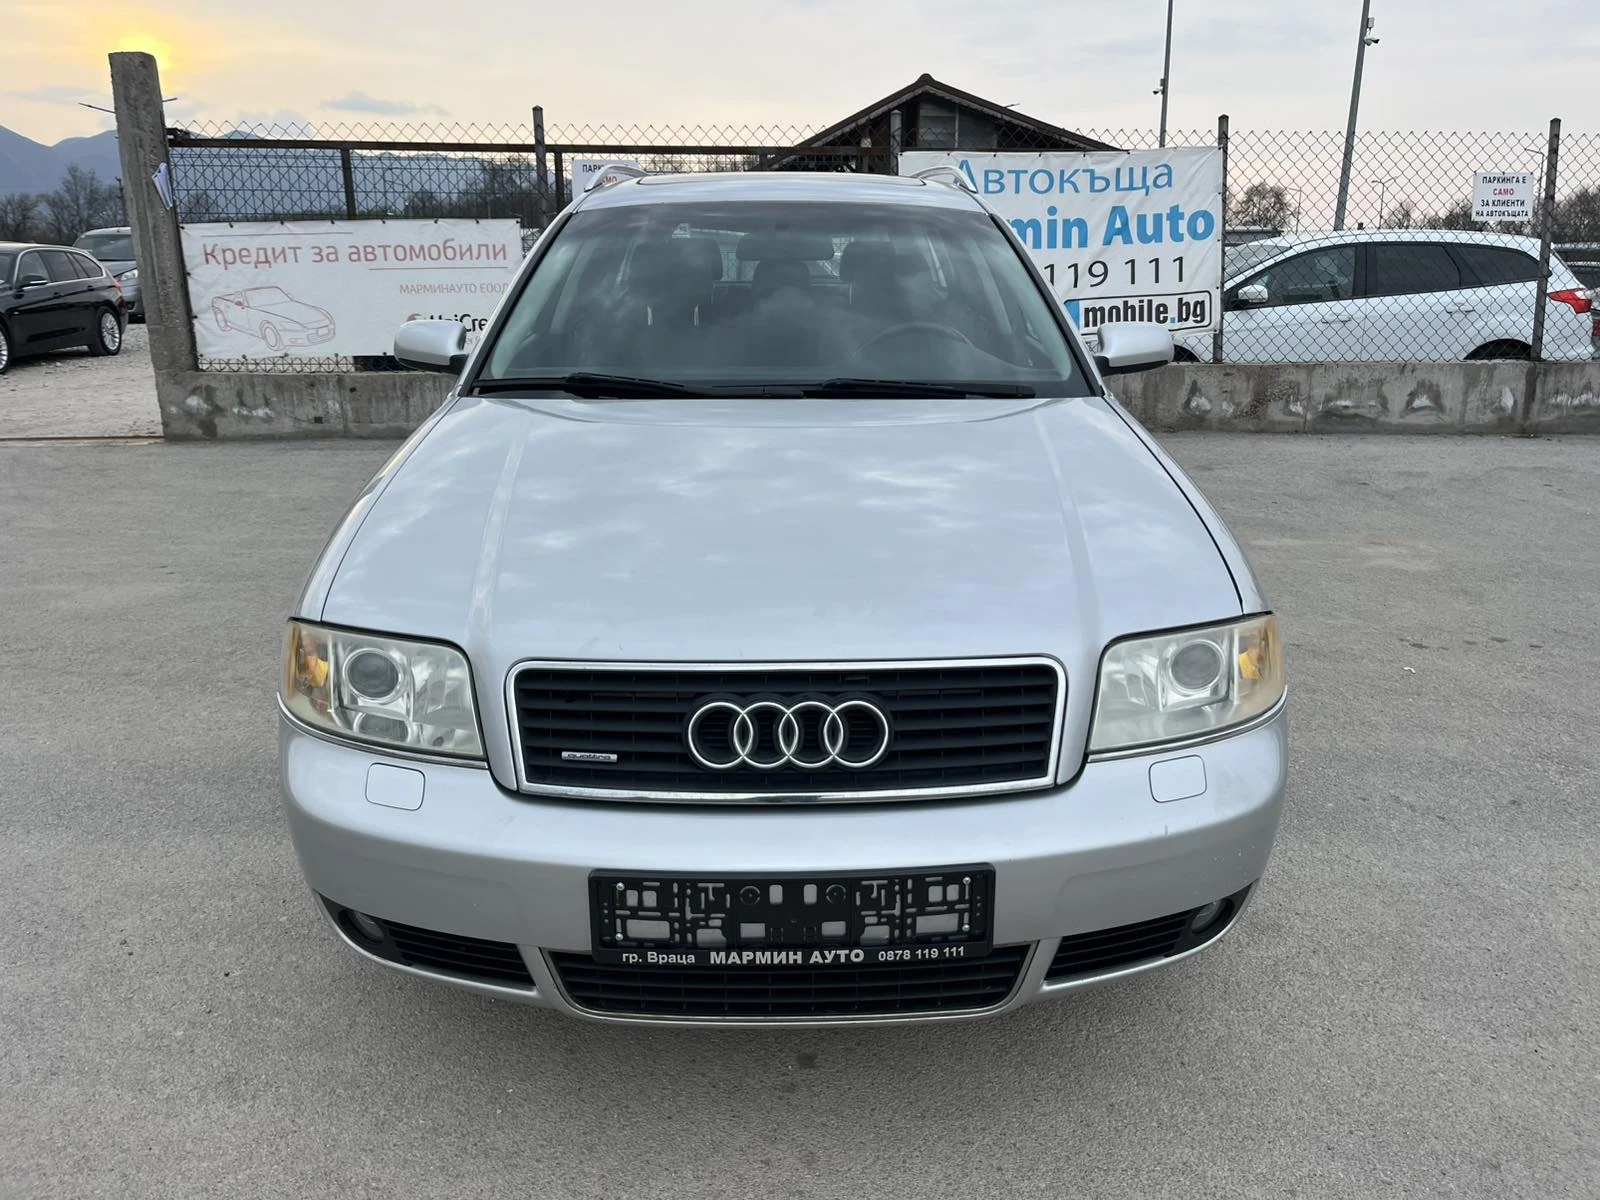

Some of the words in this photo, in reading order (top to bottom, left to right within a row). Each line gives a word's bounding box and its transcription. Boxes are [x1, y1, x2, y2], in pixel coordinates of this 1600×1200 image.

[1482, 176, 1520, 184] ПАРКИНГА
[1103, 204, 1215, 246] Auto
[203, 243, 302, 270] Кредит
[311, 245, 339, 263] за
[348, 239, 507, 262] автомобили
[1044, 260, 1109, 288] 119
[1124, 256, 1184, 285] 111
[400, 284, 477, 294] МАРМИНАУТО
[567, 753, 611, 761] quattro
[622, 953, 642, 963] гр.
[647, 952, 695, 964] Враца
[709, 951, 802, 964] МАРМИН
[809, 949, 864, 964] АУТО
[878, 950, 911, 961] 0878
[915, 948, 939, 959] 119
[943, 946, 965, 957] 111
